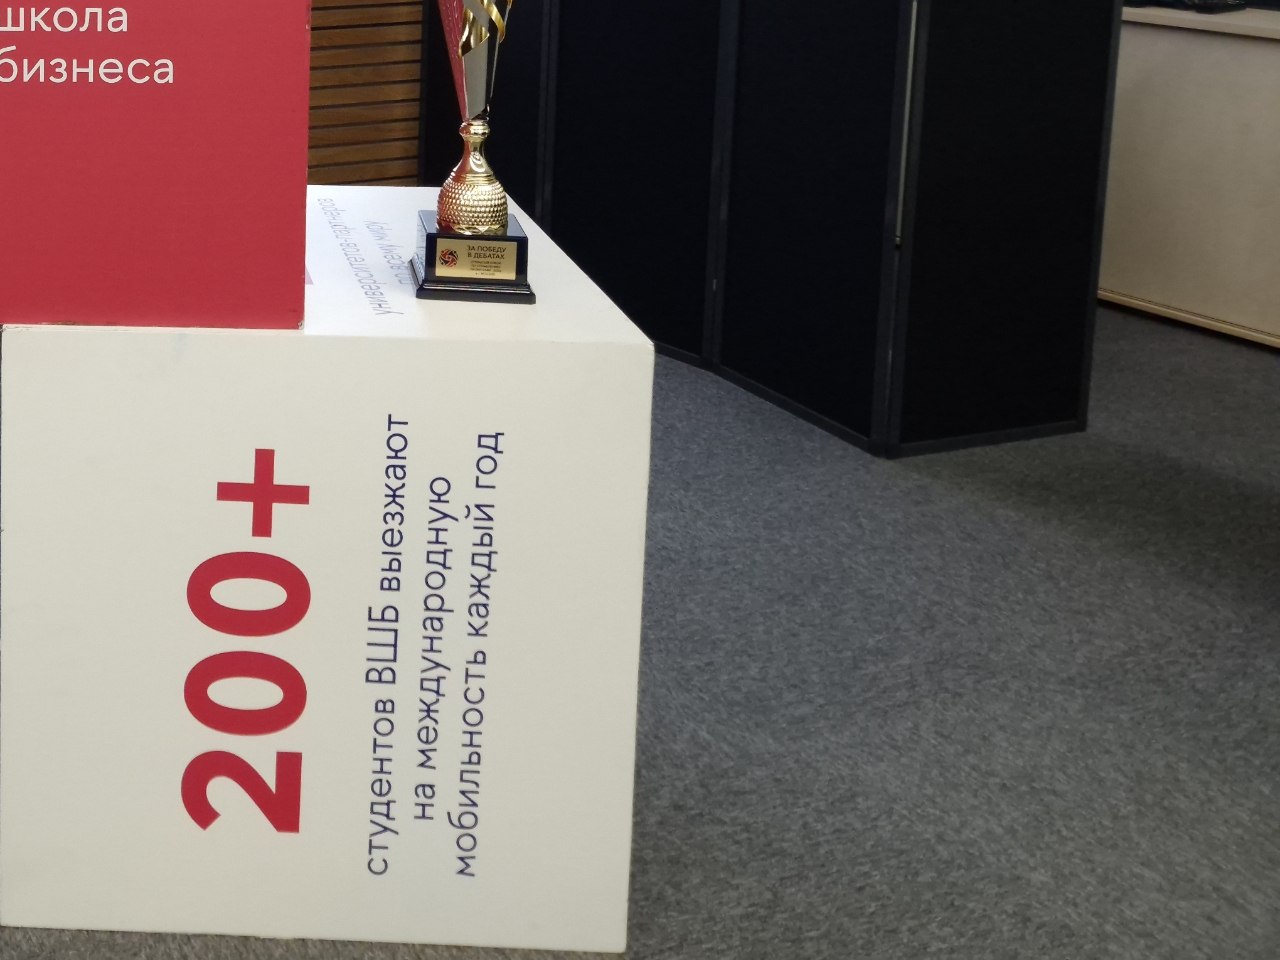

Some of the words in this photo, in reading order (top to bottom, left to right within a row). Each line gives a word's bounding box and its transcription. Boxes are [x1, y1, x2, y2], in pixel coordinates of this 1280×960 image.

[477, 245, 507, 253] ПОБЕДУ
[379, 413, 409, 592] выезжают
[475, 431, 505, 490] год
[180, 448, 312, 834] 200+
[365, 606, 400, 685] ВШБ
[416, 476, 459, 770] международную
[464, 504, 499, 638] каждый
[366, 698, 400, 876] студентов
[413, 783, 437, 821] на
[446, 650, 488, 878] мобильность
